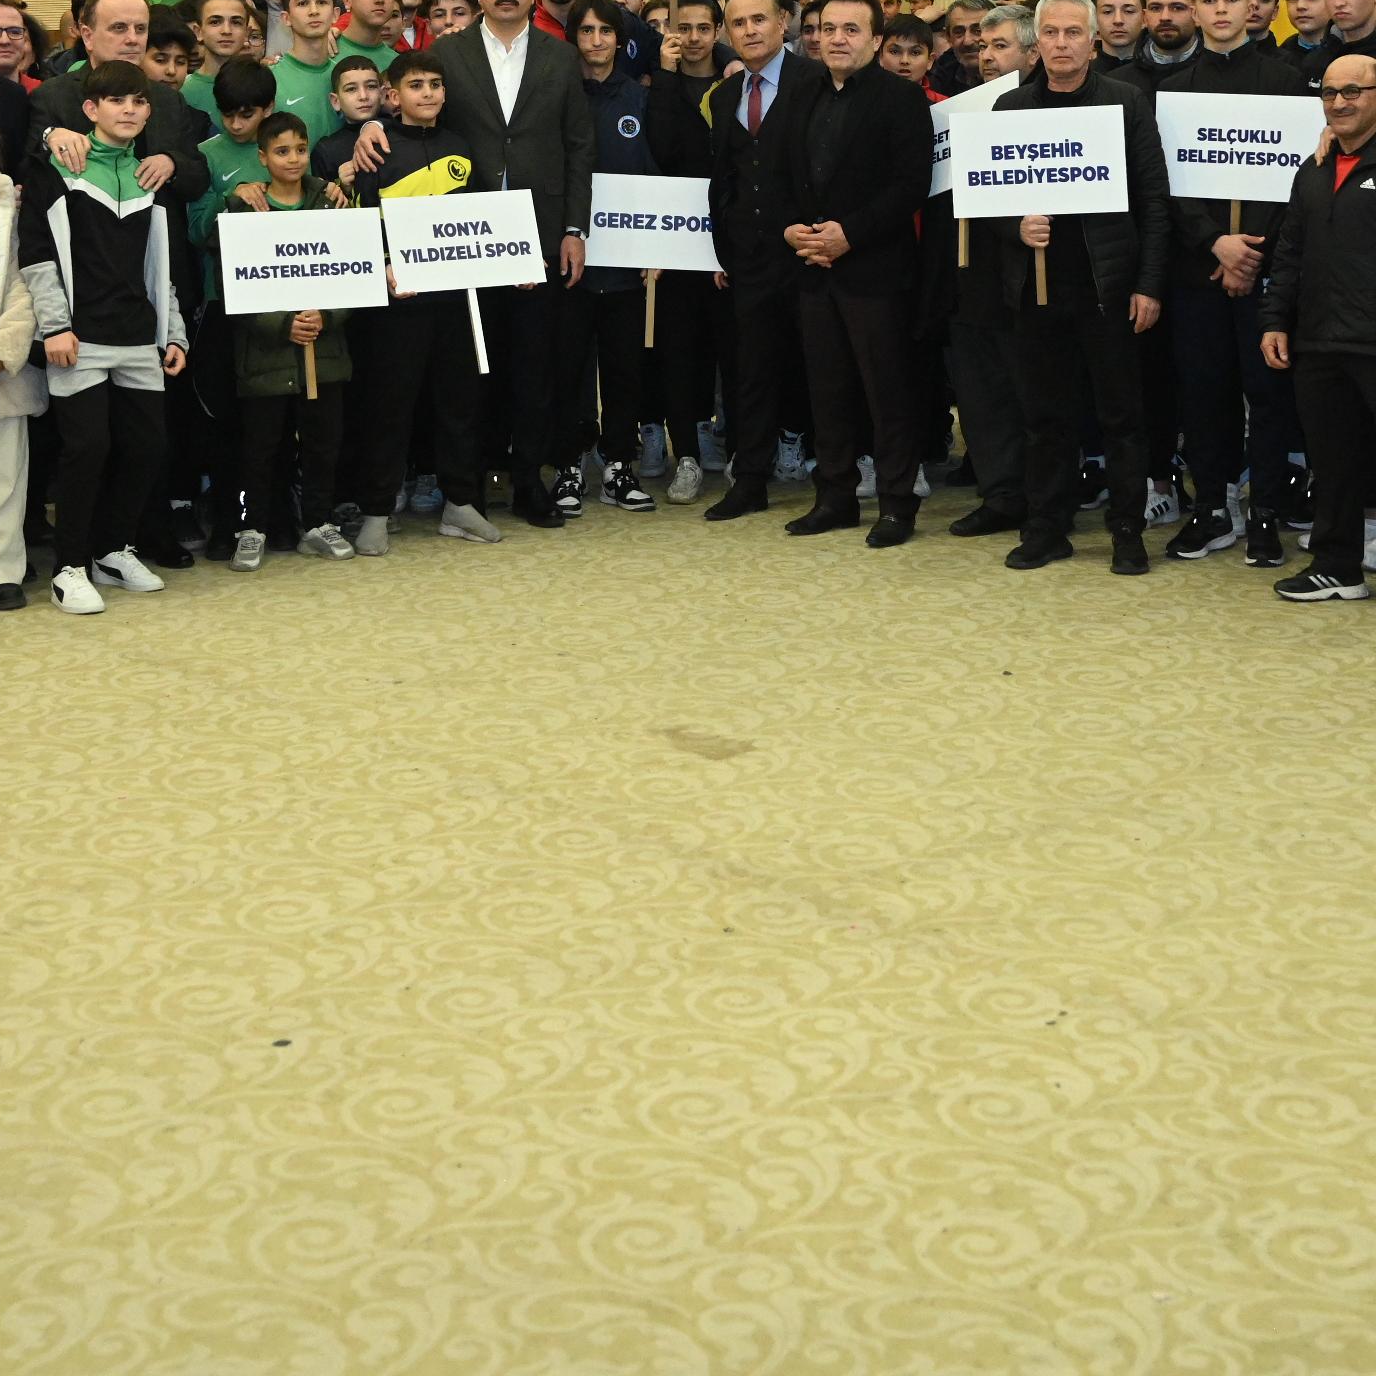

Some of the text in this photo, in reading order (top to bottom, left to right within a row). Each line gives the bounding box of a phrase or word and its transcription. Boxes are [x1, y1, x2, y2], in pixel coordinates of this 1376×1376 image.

[1196, 127, 1282, 145] SELÇUKLU
[990, 138, 1084, 163] BEYŞEHİR
[1176, 148, 1302, 168] BELEDİYESPOR
[967, 165, 1111, 186] BELEDİYESPOR
[432, 220, 493, 238] KONYA
[593, 211, 713, 232] GEREZ SPOR
[275, 242, 331, 257] KONYA
[400, 240, 532, 264] YILDIZELİ SPOR
[235, 261, 374, 280] MASTERLERSPOR
